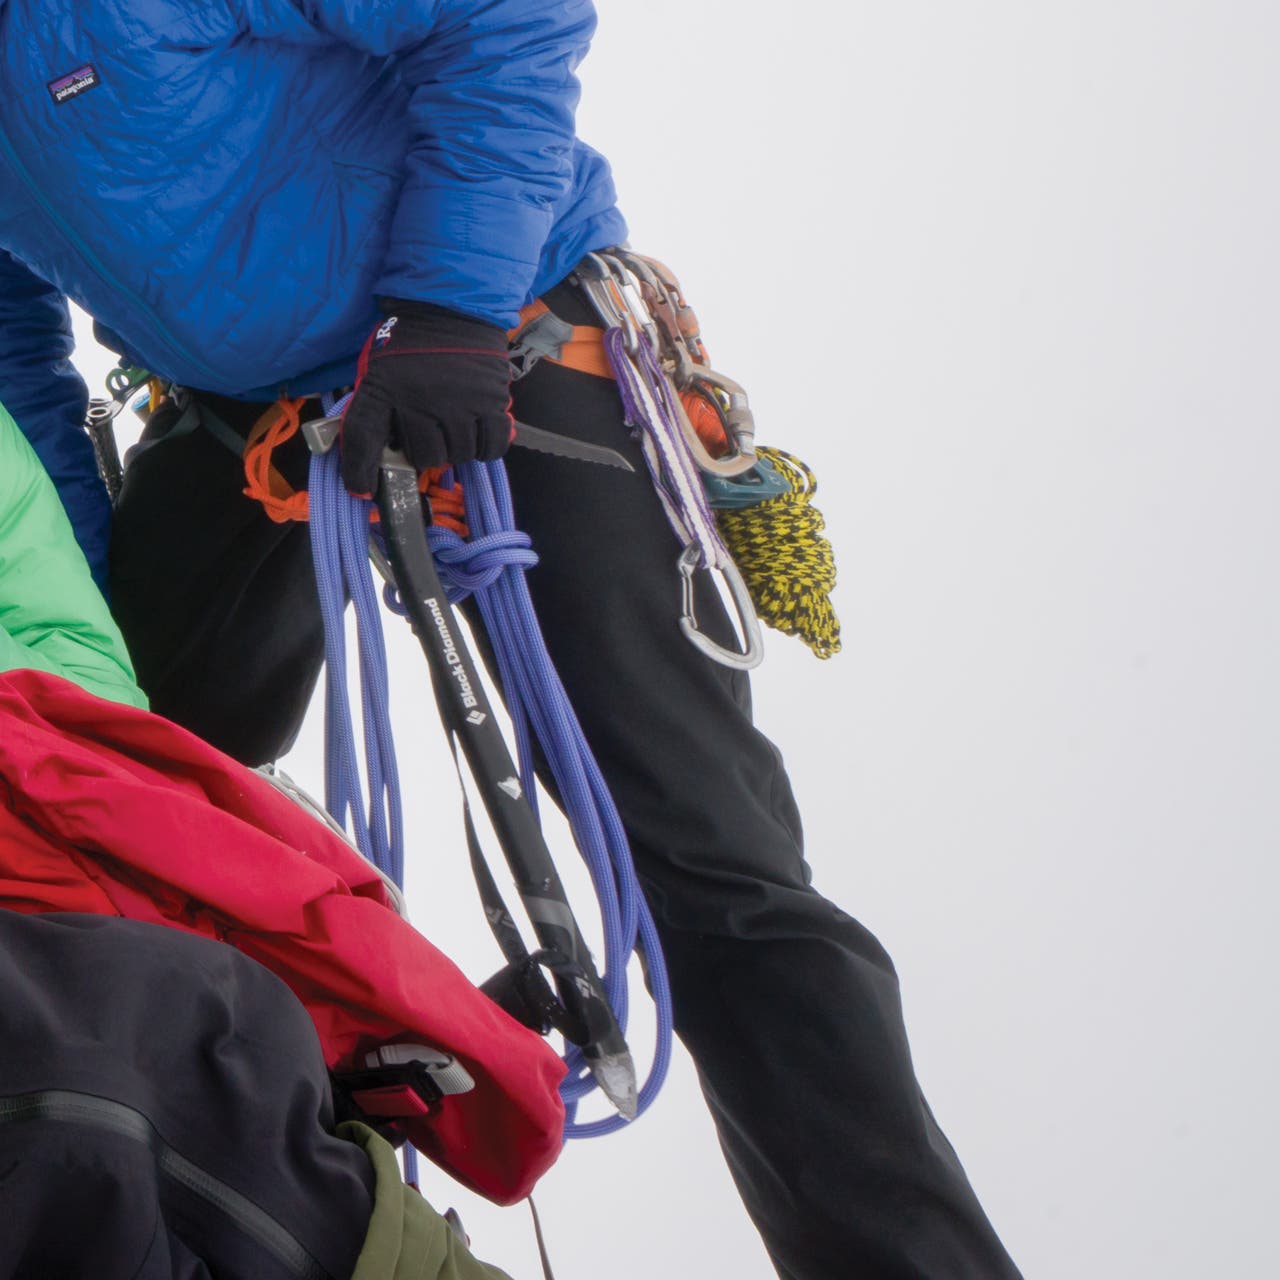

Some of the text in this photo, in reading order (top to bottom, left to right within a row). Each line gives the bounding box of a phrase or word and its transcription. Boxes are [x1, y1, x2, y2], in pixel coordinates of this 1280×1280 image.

[56, 76, 95, 101] patagonia
[424, 598, 478, 708] Black Diamond
